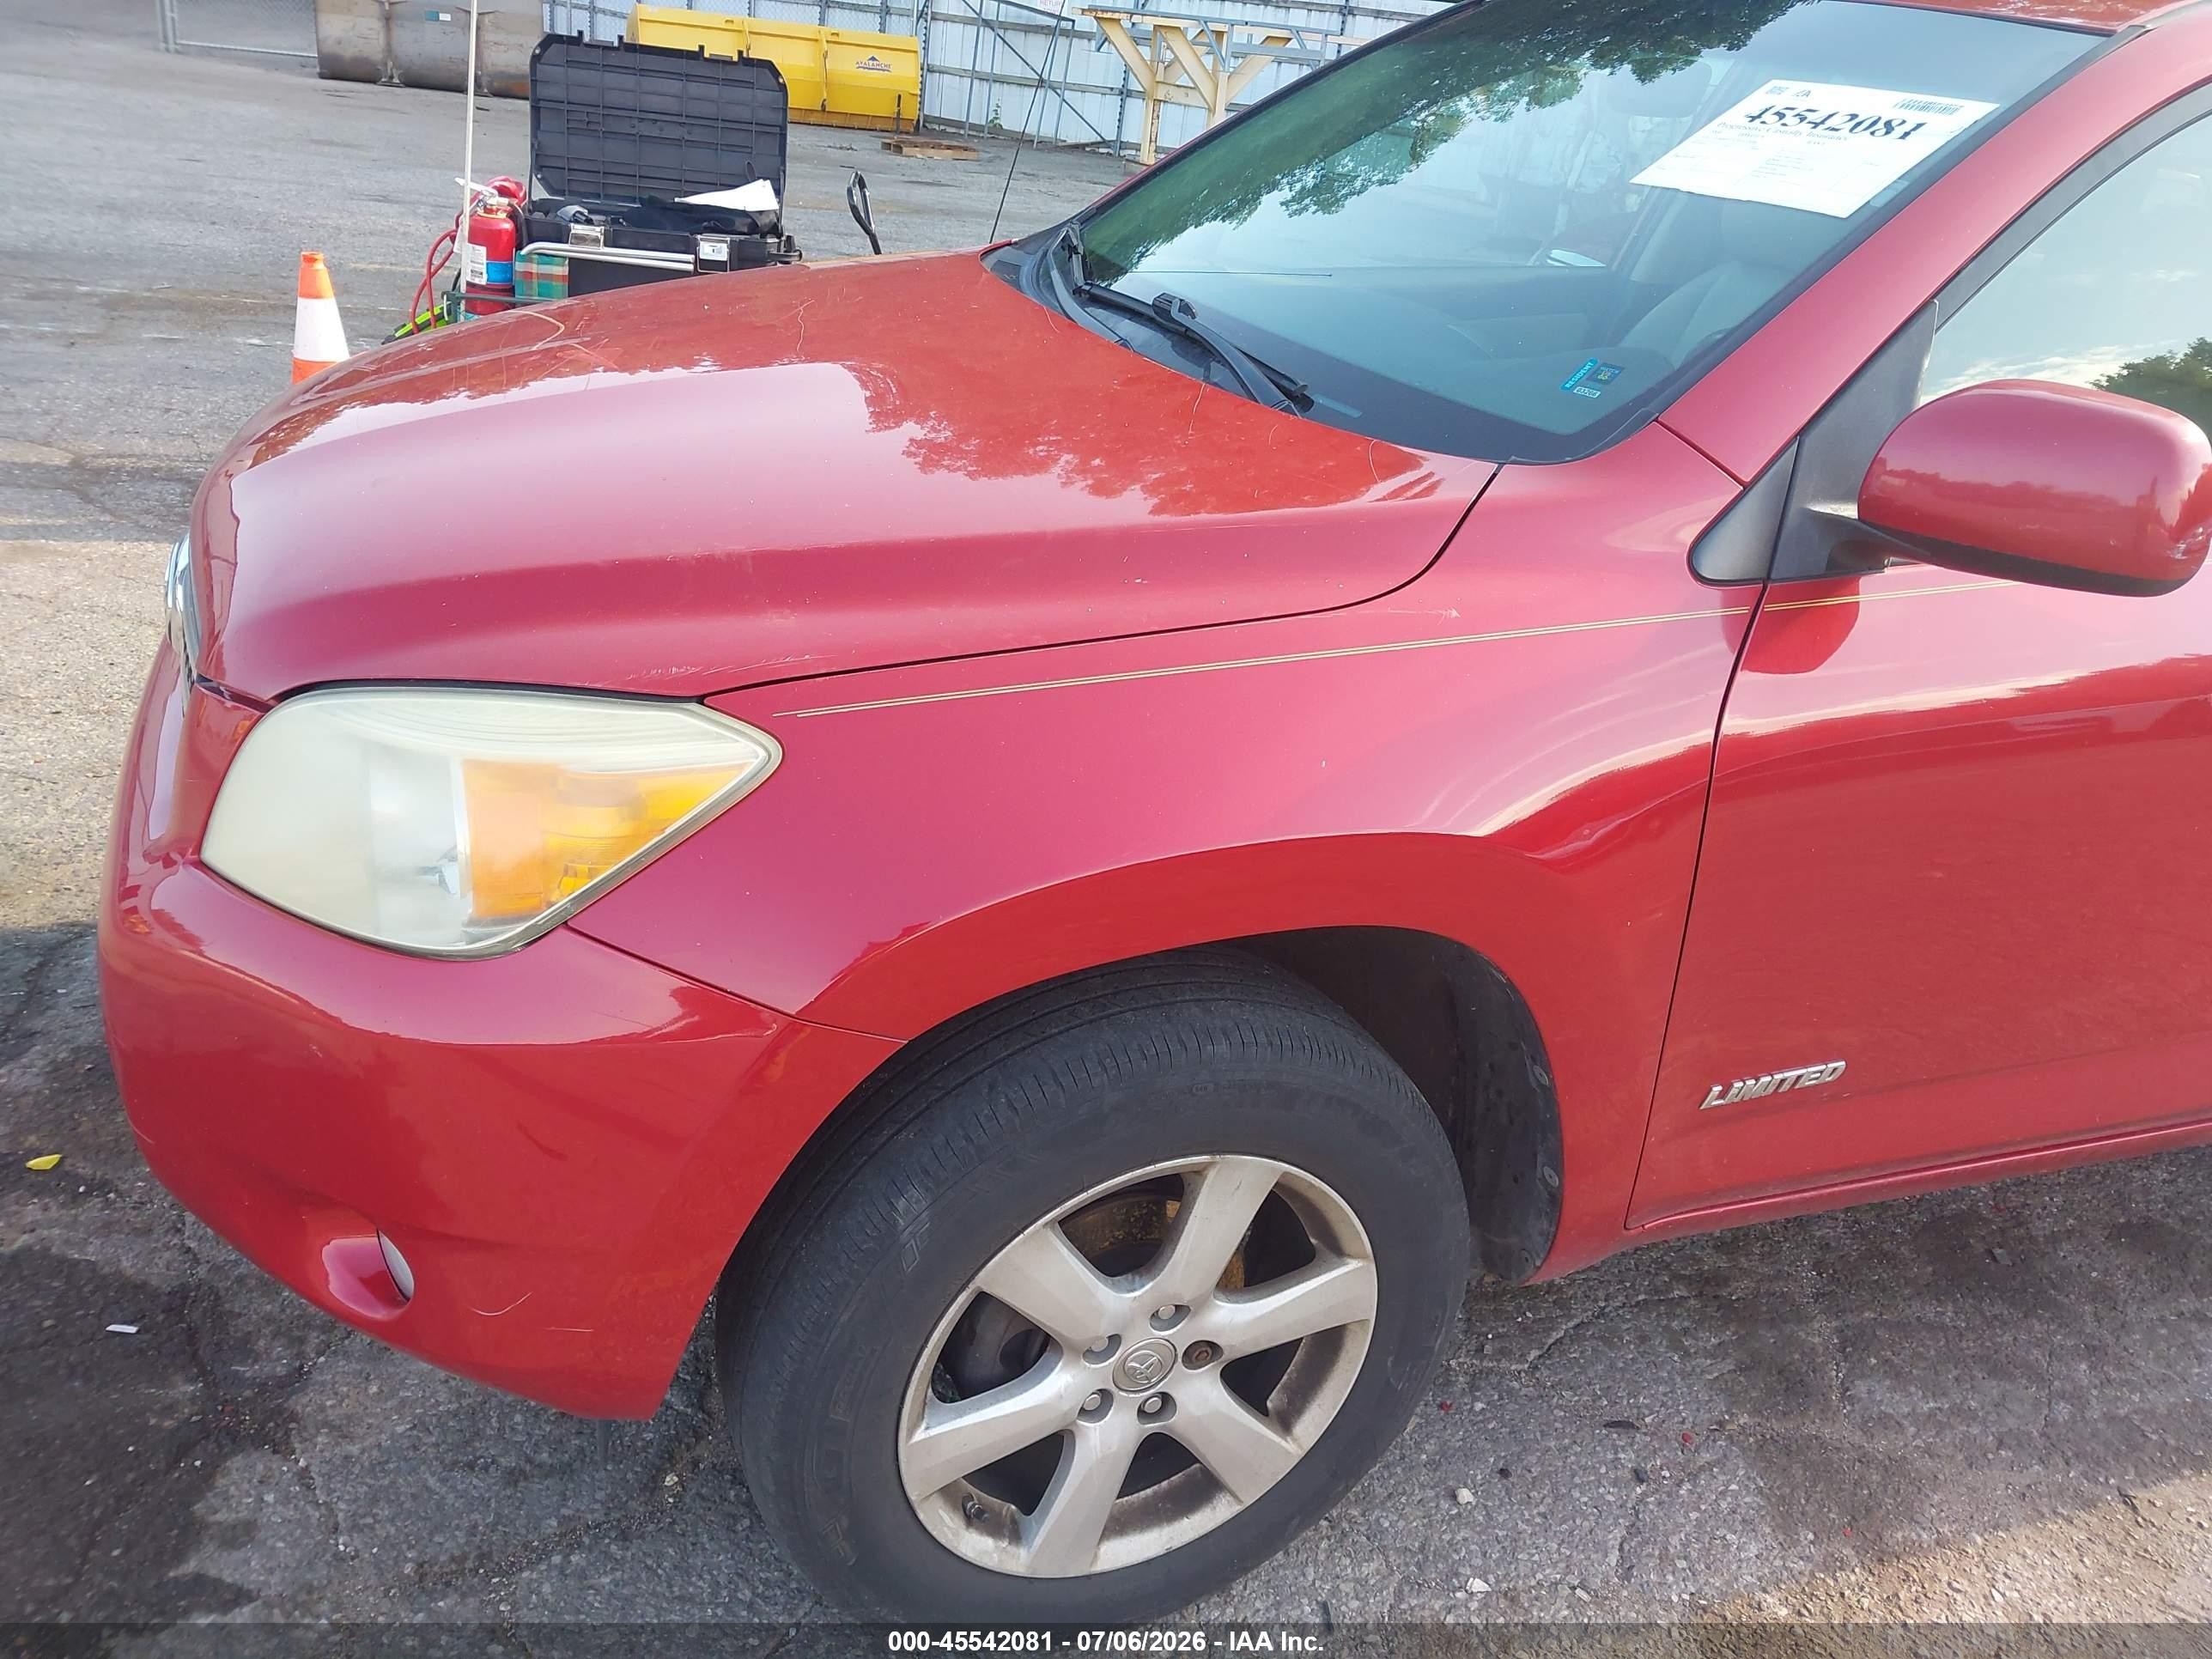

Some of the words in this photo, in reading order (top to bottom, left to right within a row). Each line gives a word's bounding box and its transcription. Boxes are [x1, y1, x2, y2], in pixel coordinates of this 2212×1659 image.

[855, 60, 892, 69] AVALANCHE
[1744, 104, 1929, 141] 45542081
[1564, 362, 1595, 388] RESIDENT
[1699, 1060, 1846, 1110] LIMITED
